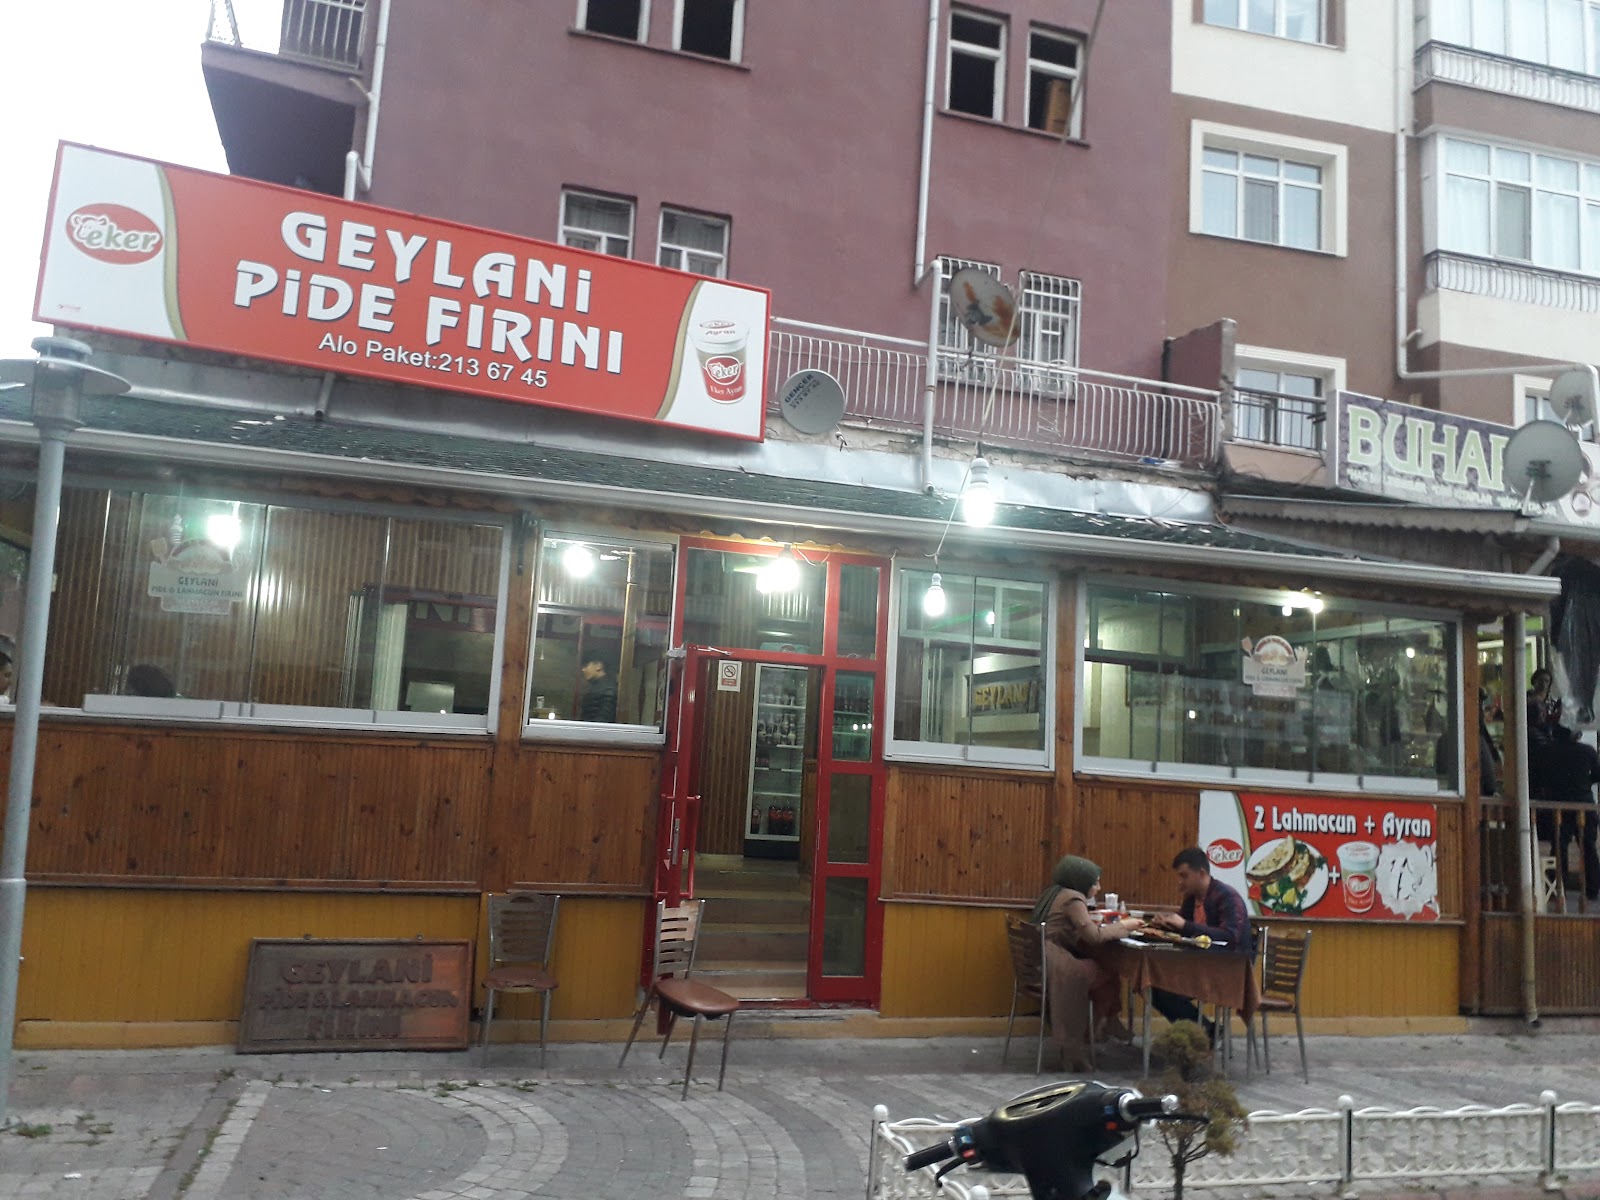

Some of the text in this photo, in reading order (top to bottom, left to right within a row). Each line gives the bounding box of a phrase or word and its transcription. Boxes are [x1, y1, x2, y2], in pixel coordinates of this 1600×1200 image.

[319, 332, 548, 388] Alo Paket:213 67 45
[425, 296, 624, 374] FIRINI
[1254, 805, 1431, 840] 2 Lahmacun + Ayran
